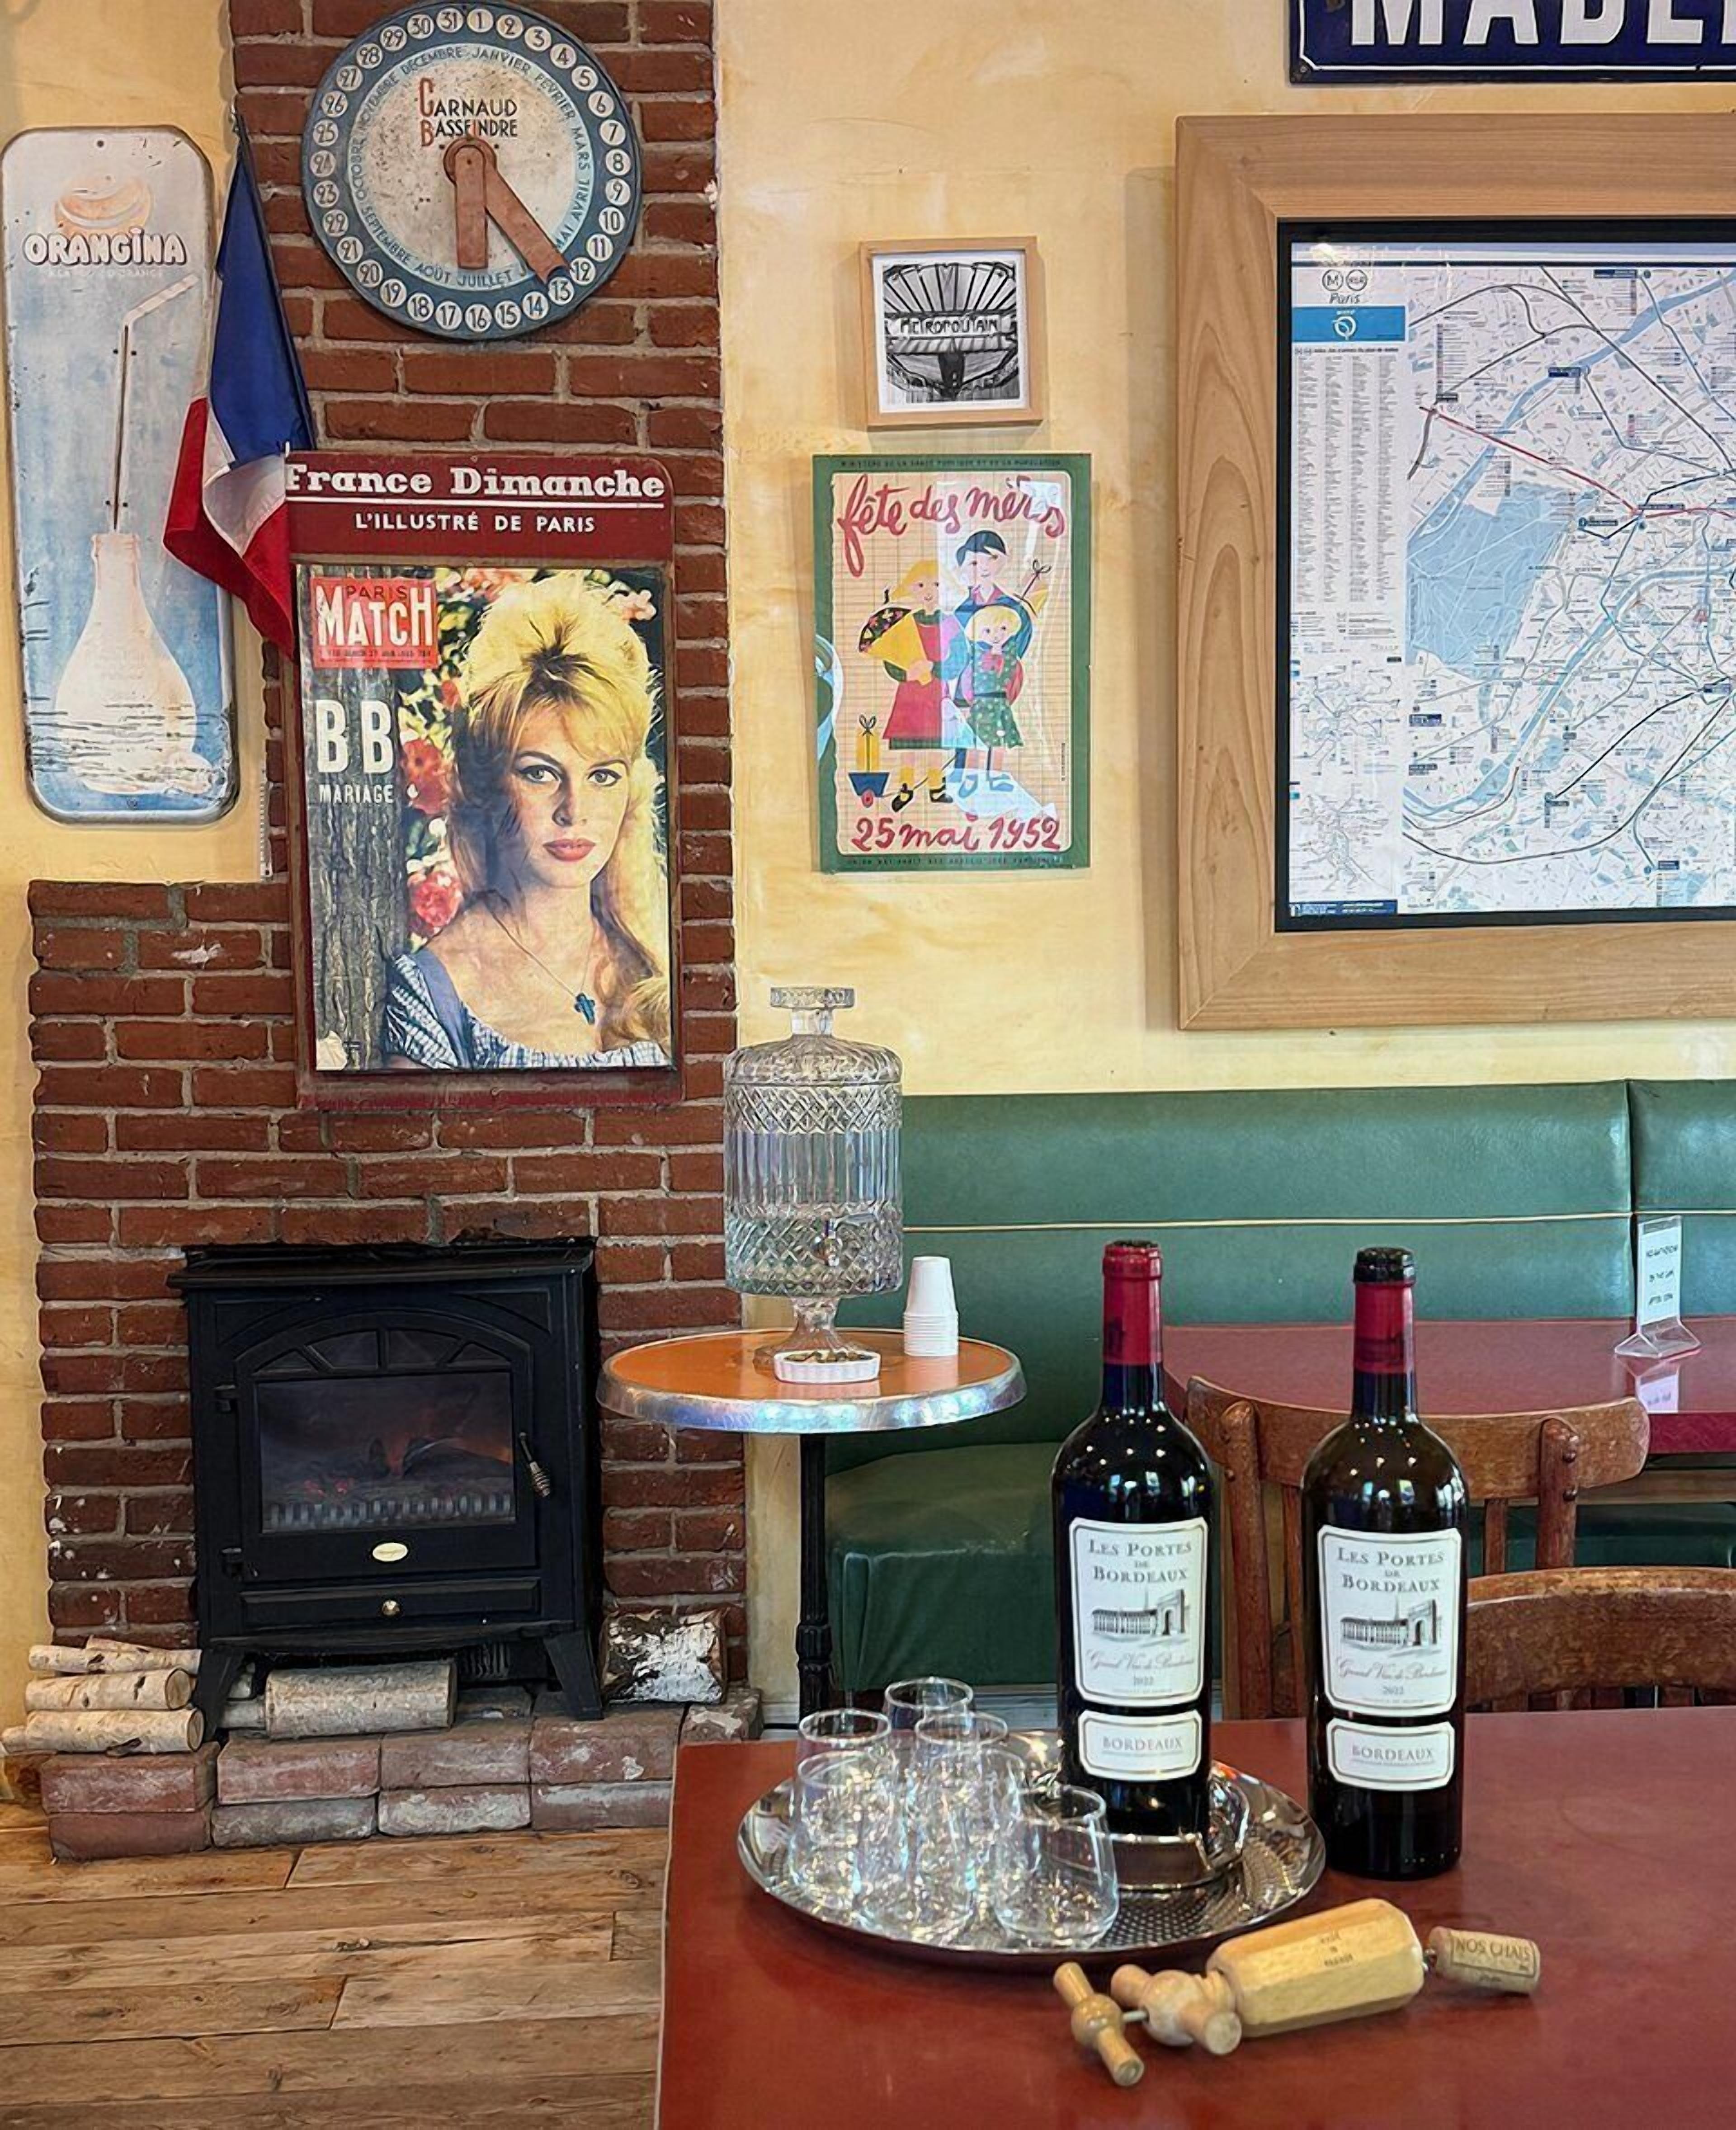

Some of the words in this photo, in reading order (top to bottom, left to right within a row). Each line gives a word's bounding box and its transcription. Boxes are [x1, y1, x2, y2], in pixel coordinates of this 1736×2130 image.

[412, 17, 431, 35] 30
[442, 11, 458, 29] 31
[477, 12, 482, 29] 1
[504, 17, 515, 36] 2
[383, 29, 404, 47] 29
[533, 29, 545, 47] 3
[359, 46, 380, 65] 28
[556, 47, 569, 65] 4
[340, 68, 357, 87] 27
[578, 69, 591, 87] 5
[325, 94, 344, 114] 26
[420, 77, 518, 117] CARNAUD
[596, 95, 606, 113] 6
[316, 123, 335, 143] 25
[609, 123, 618, 141] 7
[571, 126, 590, 170] MARS
[316, 184, 337, 204] 23
[571, 179, 590, 220] AVRIL
[613, 182, 623, 201] 9
[325, 213, 345, 234] 22
[602, 211, 621, 231] 10
[340, 240, 359, 261] 21
[592, 237, 606, 257] 11
[359, 263, 380, 284] 20
[457, 270, 512, 287] JUILLET
[575, 261, 591, 282] 12
[385, 282, 401, 303] 19
[552, 280, 571, 302] 13
[411, 296, 430, 318] 18
[440, 305, 456, 326] 17
[499, 304, 517, 325] 15
[526, 295, 543, 316] 14
[470, 308, 487, 329] 16
[285, 464, 432, 495] France
[450, 467, 665, 498] Dimanche
[355, 511, 479, 531] L'ILLUSTRÉ
[495, 515, 522, 532] DE
[537, 515, 595, 533] PARIS
[837, 473, 910, 577] fête
[910, 484, 961, 534] des
[346, 585, 407, 599] PARIS
[316, 585, 433, 646] MATCH
[318, 784, 394, 805] MARIAGE
[851, 816, 895, 852] 25
[898, 813, 979, 850] mai
[988, 816, 1061, 851] 1952
[1093, 1565, 1187, 1583] BORDEAUX
[1342, 1574, 1439, 1592] BORDEAUX
[1456, 1938, 1485, 1953] NOS
